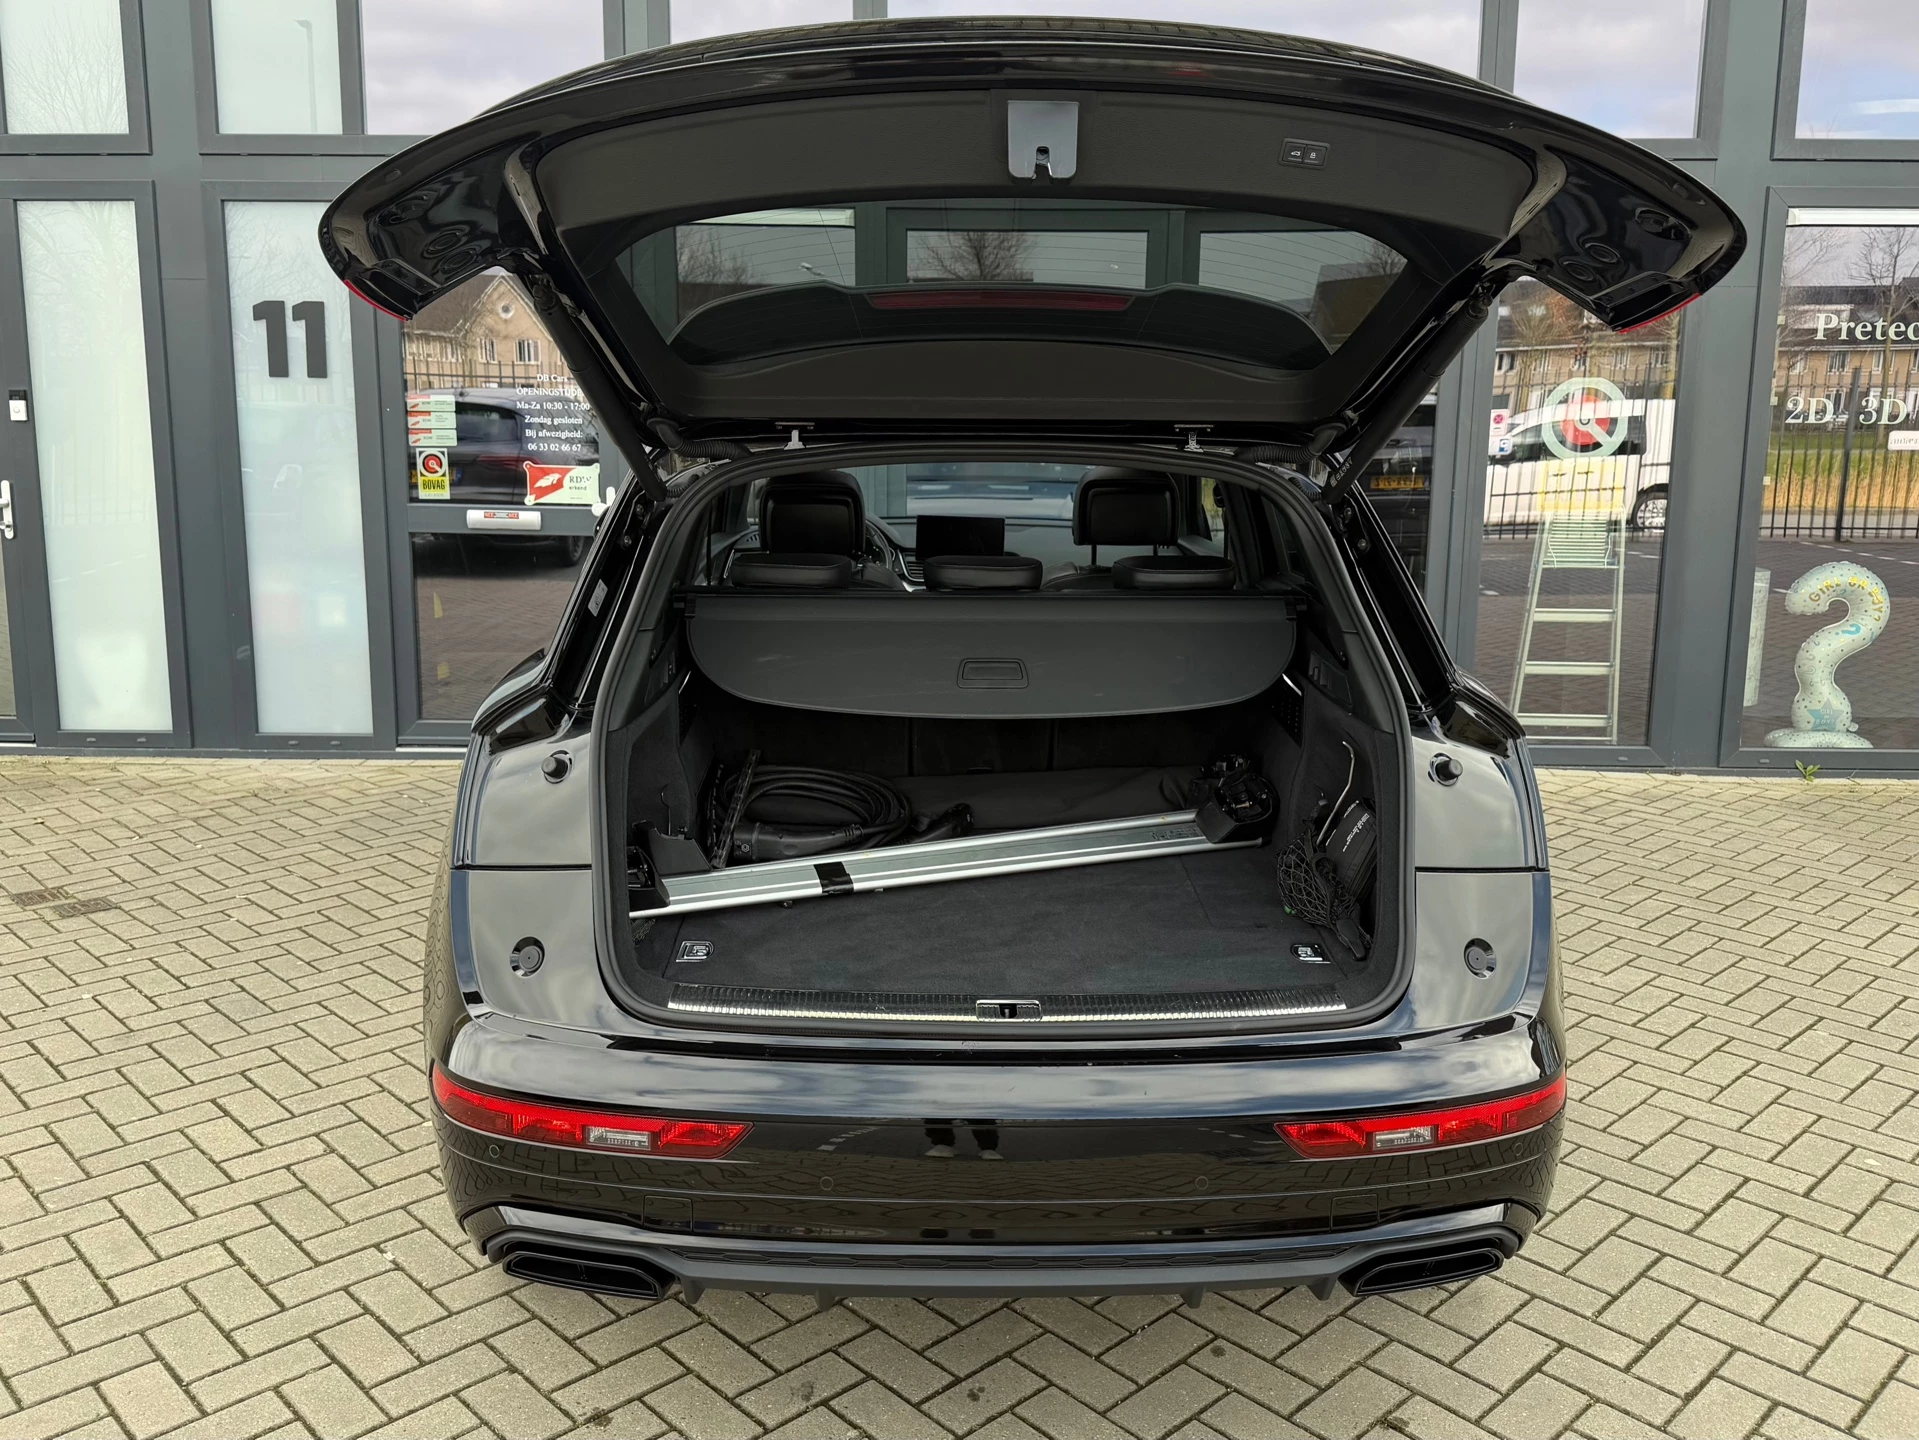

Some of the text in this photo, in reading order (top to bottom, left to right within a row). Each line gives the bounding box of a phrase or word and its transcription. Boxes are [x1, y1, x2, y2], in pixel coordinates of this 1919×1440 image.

[252, 300, 328, 378] 11
[536, 374, 568, 382] DB Cars
[516, 387, 584, 397] OPENINGSTIJDE
[516, 401, 541, 409] Ma-Za
[543, 402, 563, 410] 10:30
[570, 402, 590, 411] 17:00
[1785, 396, 1908, 425] 2D 3D
[524, 415, 583, 425] Zondag gesloten
[525, 429, 583, 440] Bij afwezigheid:
[527, 443, 538, 451] 06
[539, 443, 548, 451] 33
[549, 443, 560, 451] 02
[572, 444, 582, 452] 67
[422, 478, 446, 490] BOVAG
[1808, 577, 1842, 603] GIRL
